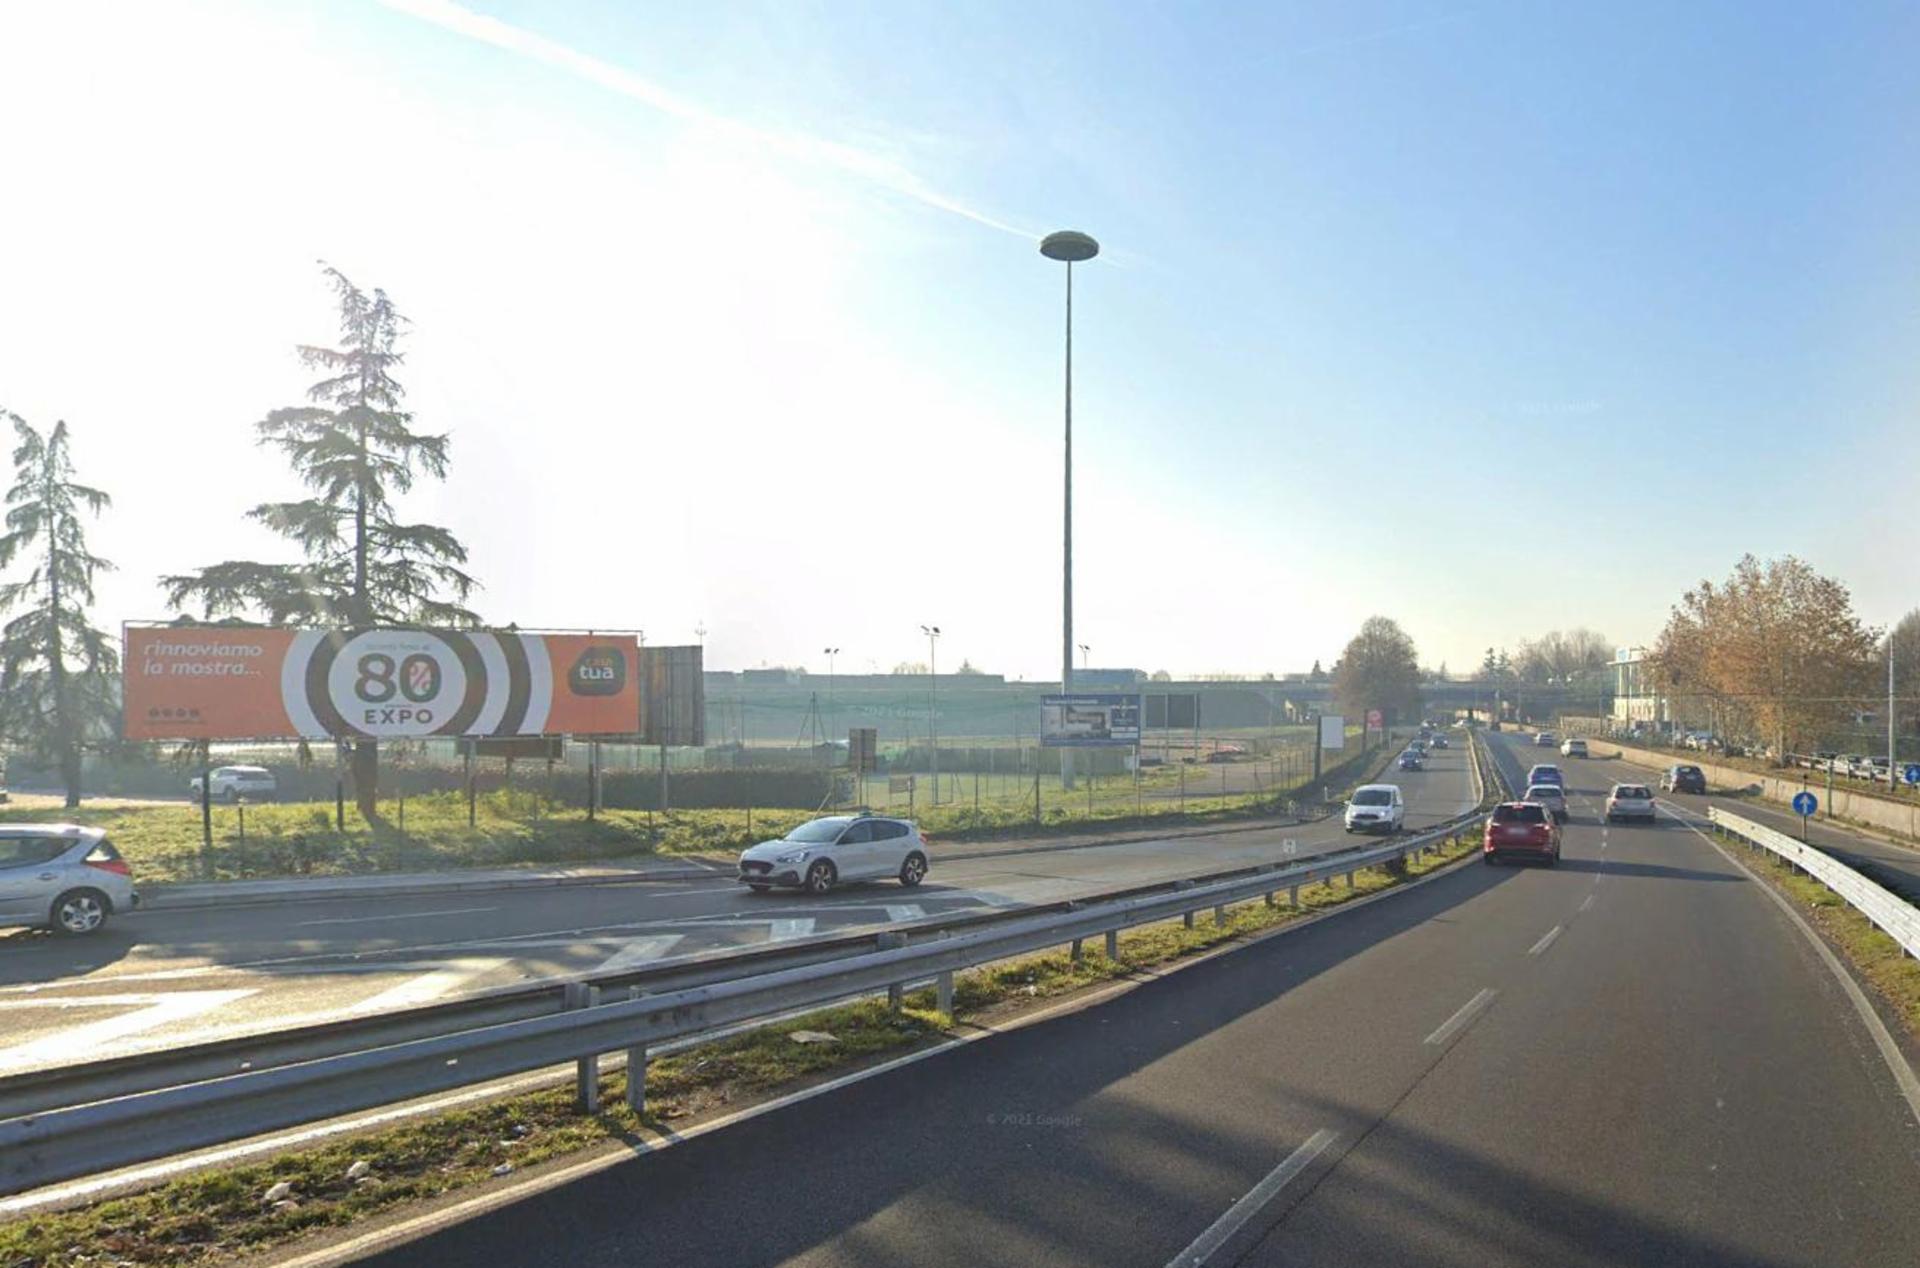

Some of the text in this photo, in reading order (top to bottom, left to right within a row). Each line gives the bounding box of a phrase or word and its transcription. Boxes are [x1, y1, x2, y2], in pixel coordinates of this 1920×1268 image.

[143, 640, 263, 657] rinnoviamo
[143, 658, 261, 676] la mostra...
[580, 665, 614, 680] tua
[364, 708, 433, 725] EXPO
